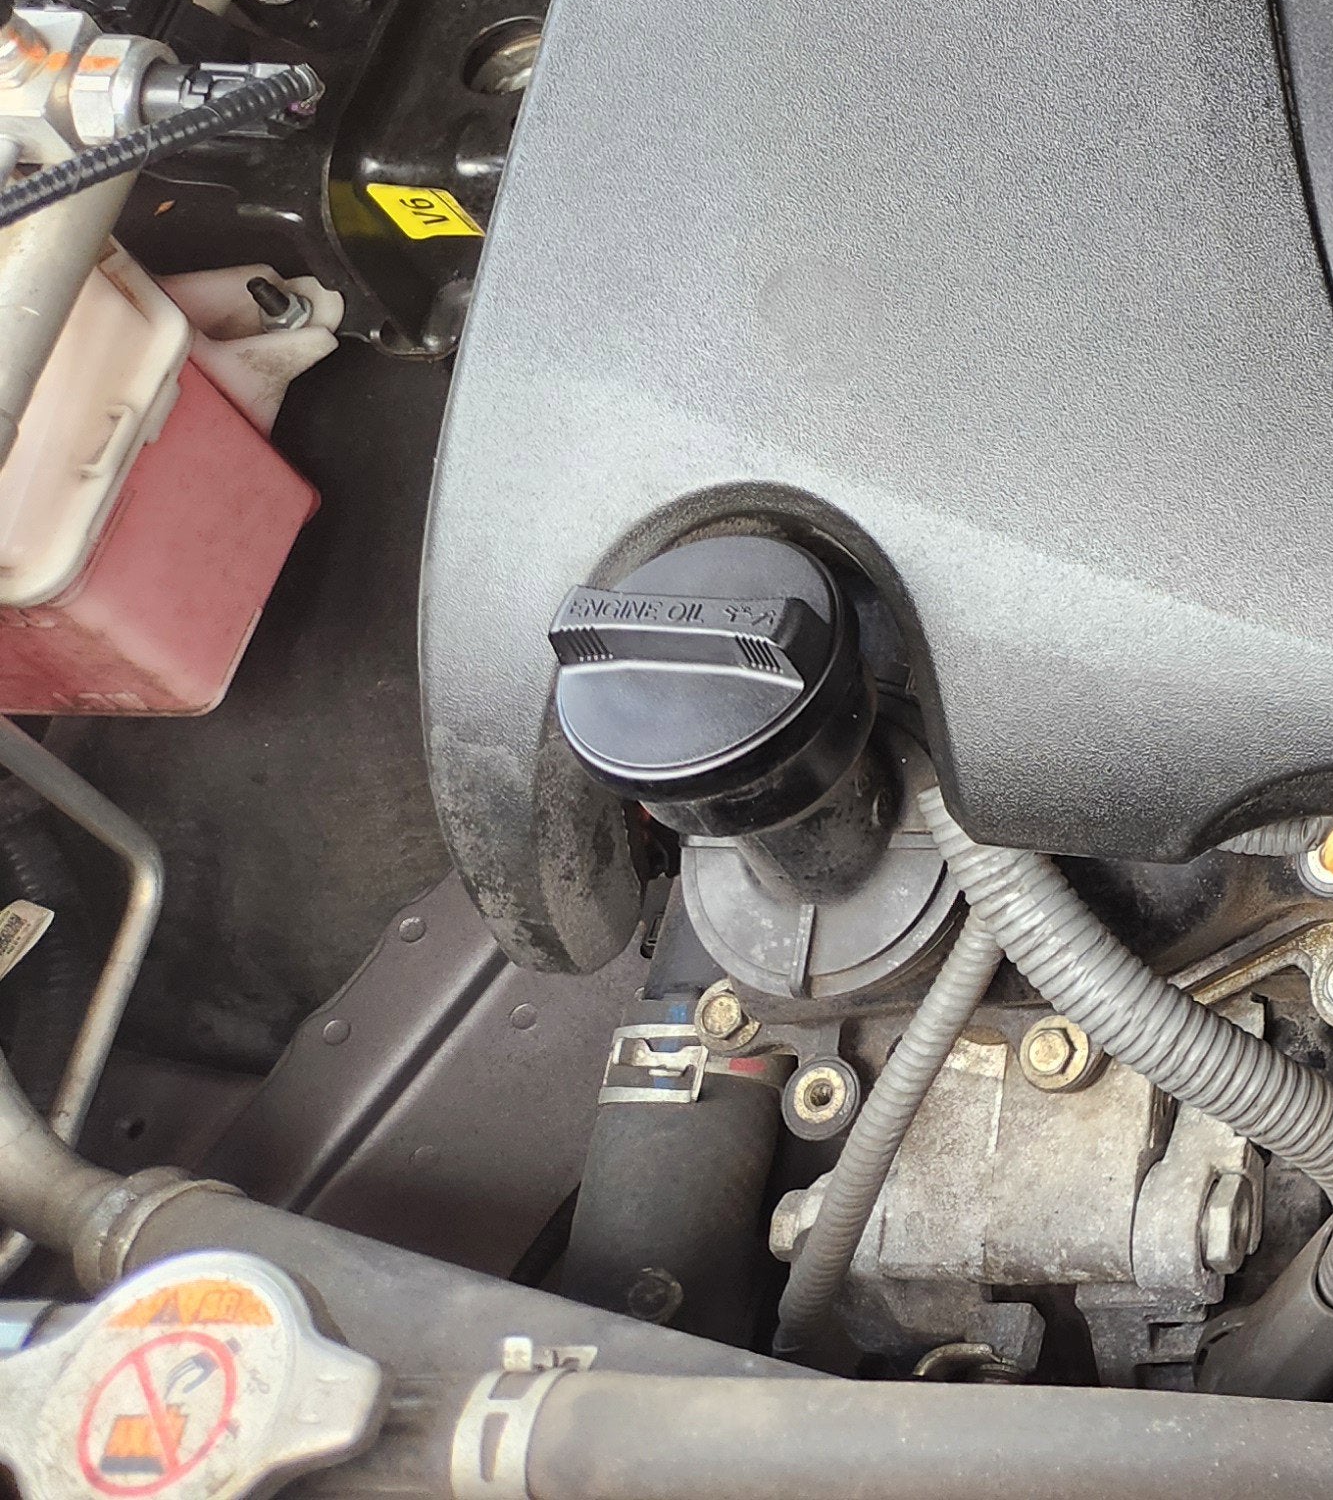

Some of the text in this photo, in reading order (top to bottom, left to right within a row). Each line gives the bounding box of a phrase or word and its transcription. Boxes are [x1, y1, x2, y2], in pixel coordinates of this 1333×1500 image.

[398, 197, 450, 226] V6
[569, 598, 704, 623] ENGINE OIL
